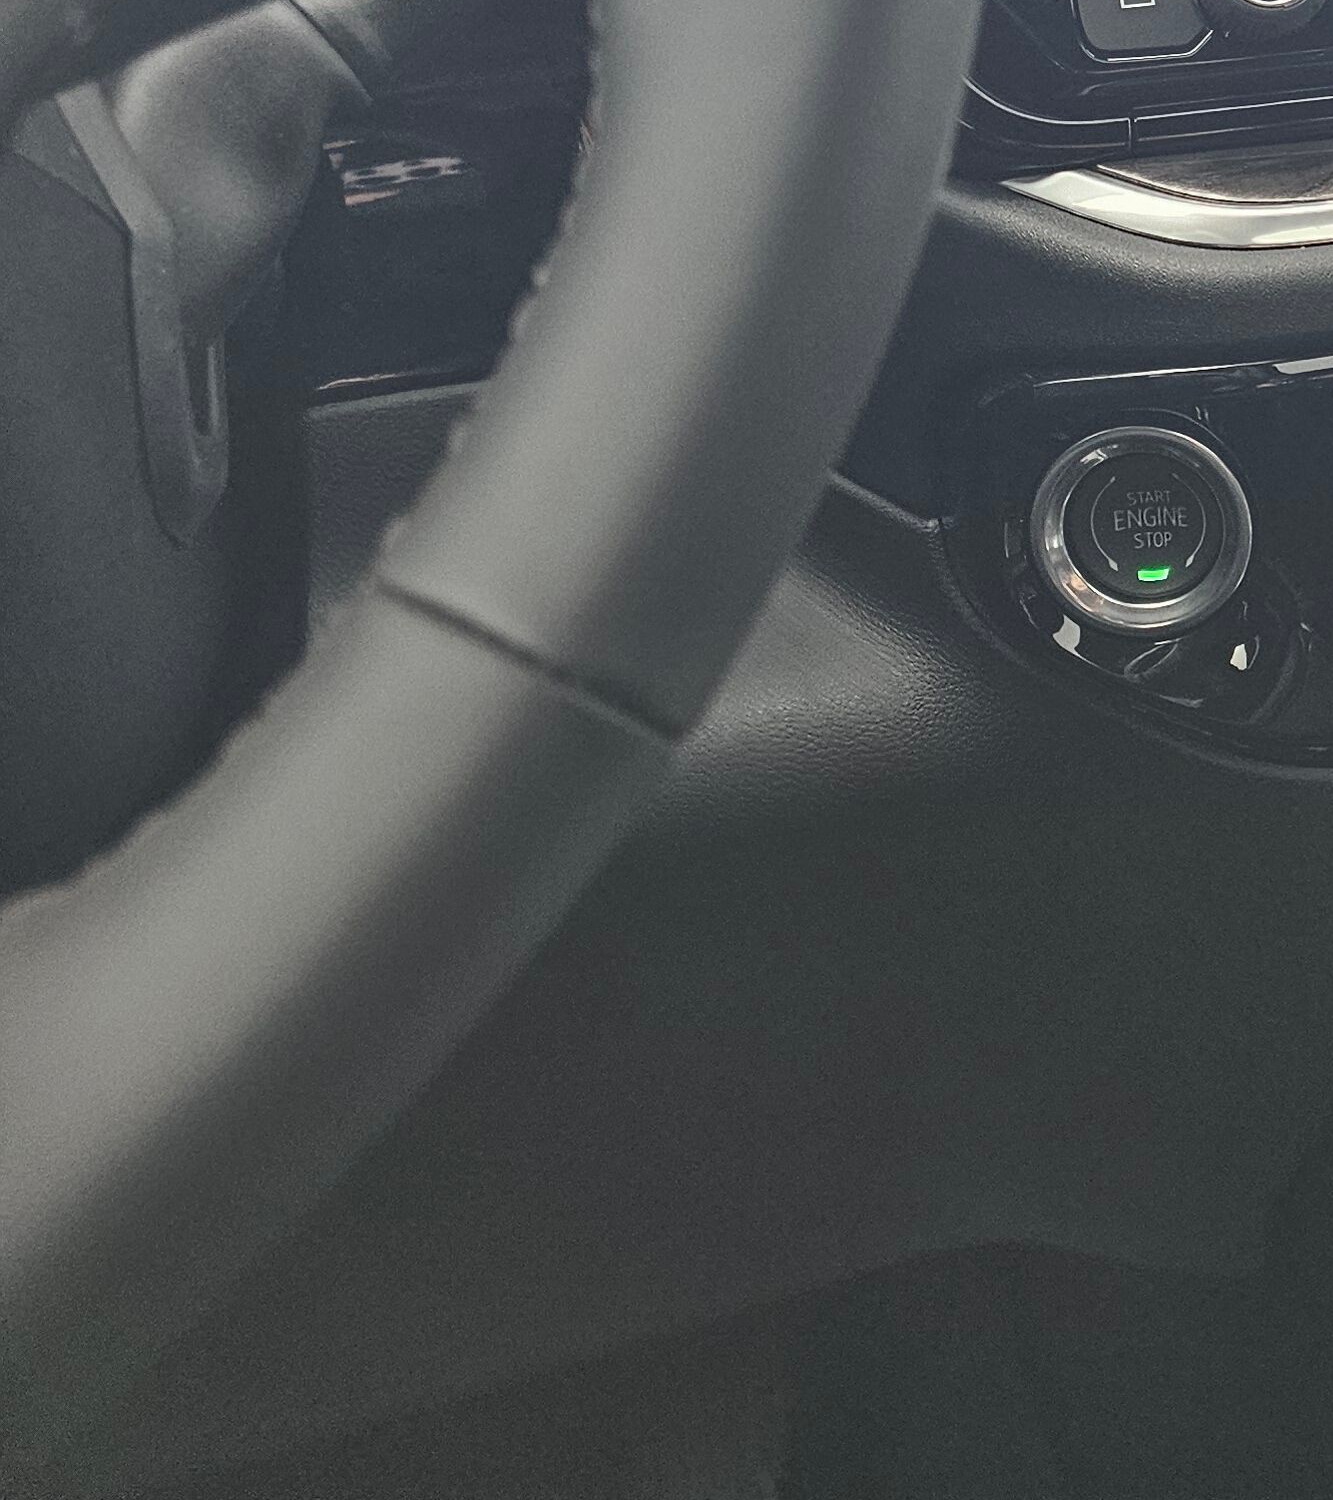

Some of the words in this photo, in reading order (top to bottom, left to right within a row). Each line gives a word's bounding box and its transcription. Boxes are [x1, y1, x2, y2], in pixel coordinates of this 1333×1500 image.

[1126, 490, 1171, 507] START
[1113, 506, 1189, 532] ENGINE
[1133, 531, 1173, 549] STOP
